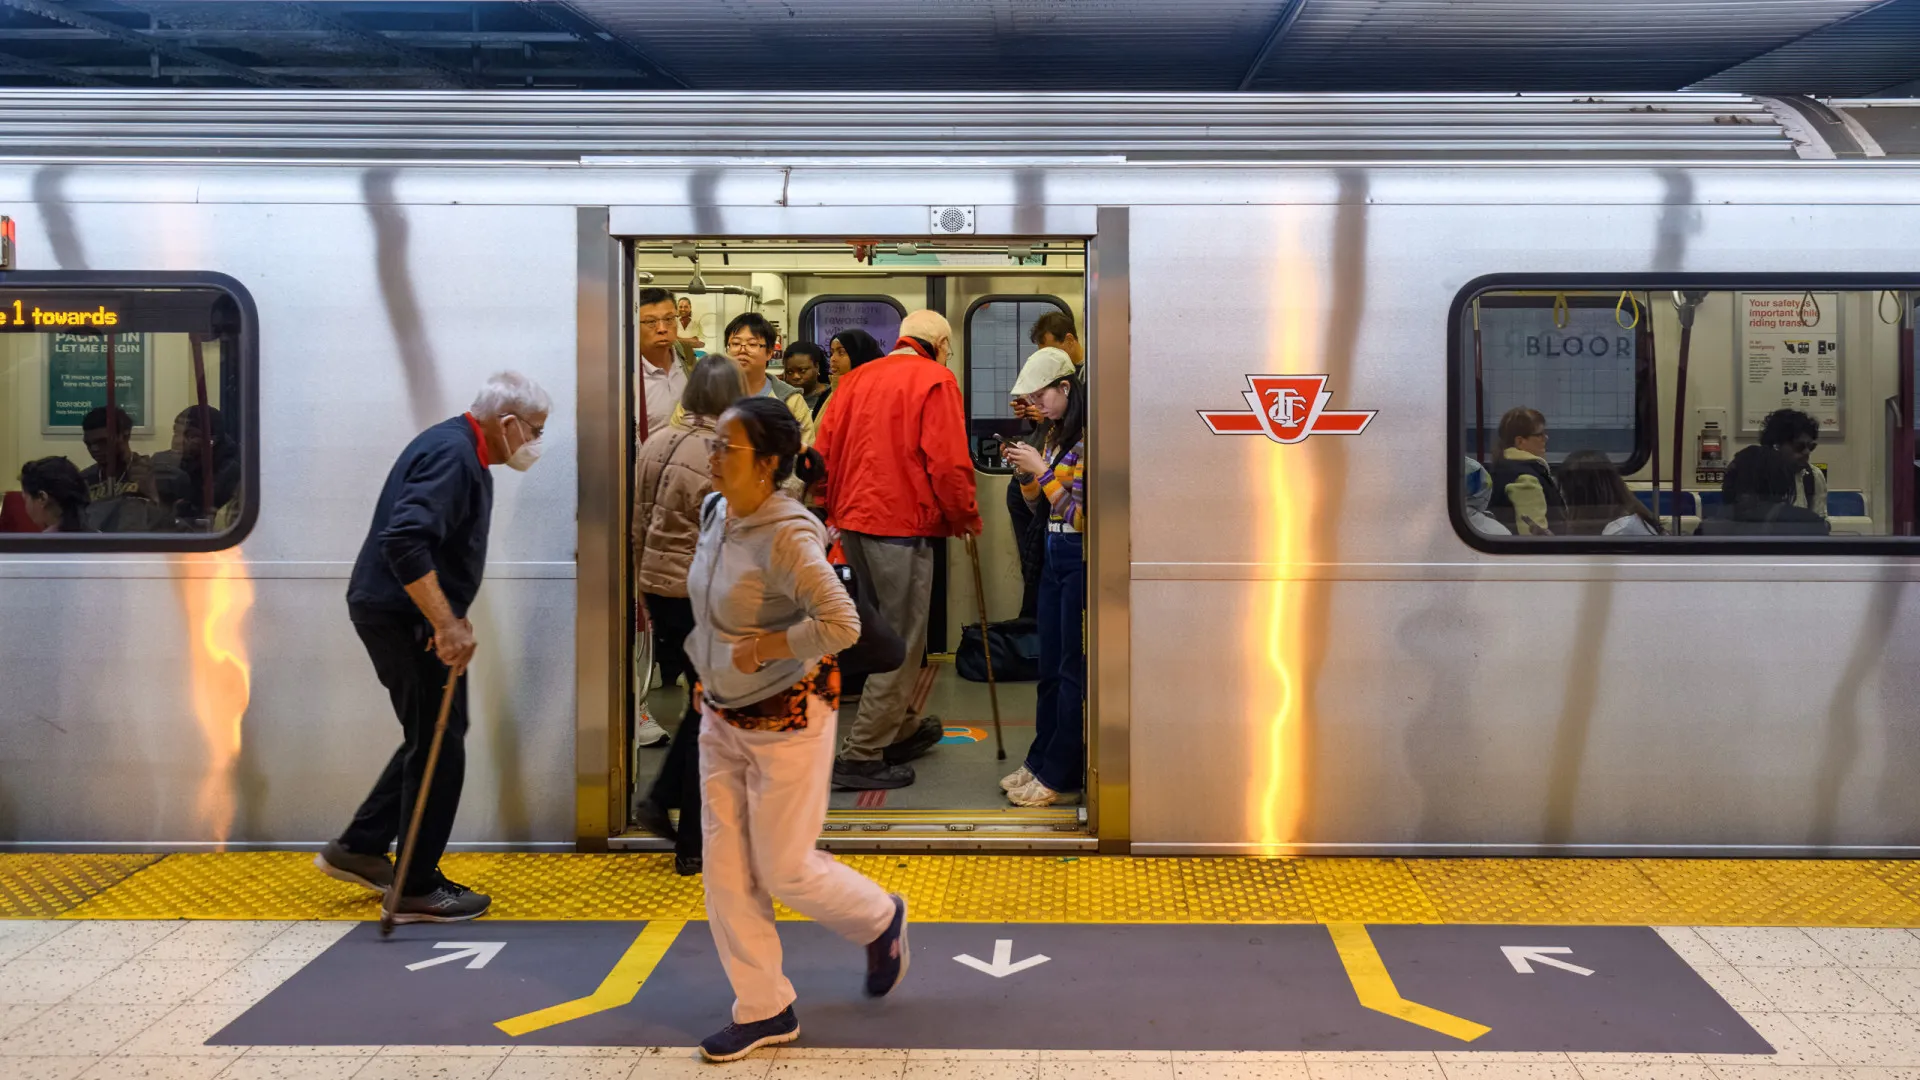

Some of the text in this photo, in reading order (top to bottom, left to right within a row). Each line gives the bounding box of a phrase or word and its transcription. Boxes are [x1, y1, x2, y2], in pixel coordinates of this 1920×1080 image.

[1749, 299, 1770, 307] Your
[1773, 299, 1801, 309] safety
[13, 299, 25, 325] 1
[31, 305, 118, 325] towards
[1749, 309, 1794, 319] important
[1749, 319, 1776, 329] riding
[122, 332, 140, 343] IN
[55, 344, 140, 353] LET ME BGIN
[1526, 335, 1630, 356] BLOOR
